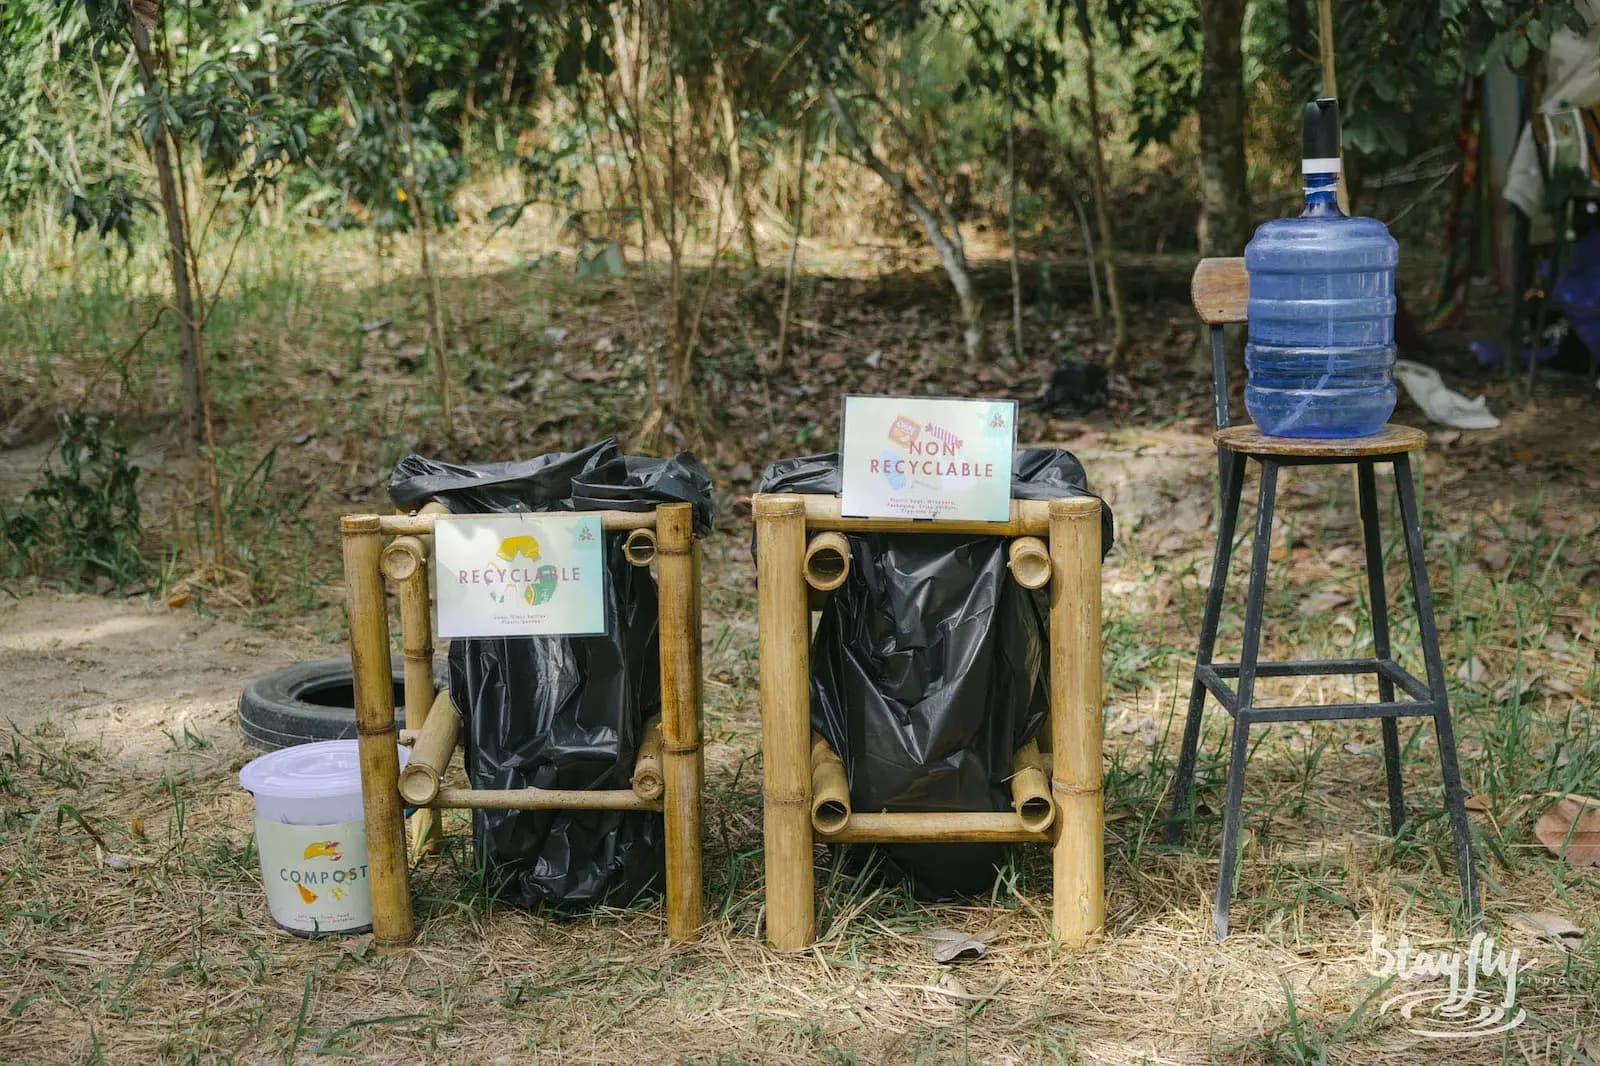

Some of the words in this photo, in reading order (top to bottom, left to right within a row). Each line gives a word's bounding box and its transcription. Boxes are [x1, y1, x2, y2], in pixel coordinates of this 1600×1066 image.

[910, 441, 955, 456] NON
[871, 459, 993, 477] RECYCLABLE
[459, 567, 581, 584] RECYCLABLE
[280, 865, 368, 884] COMPOST
